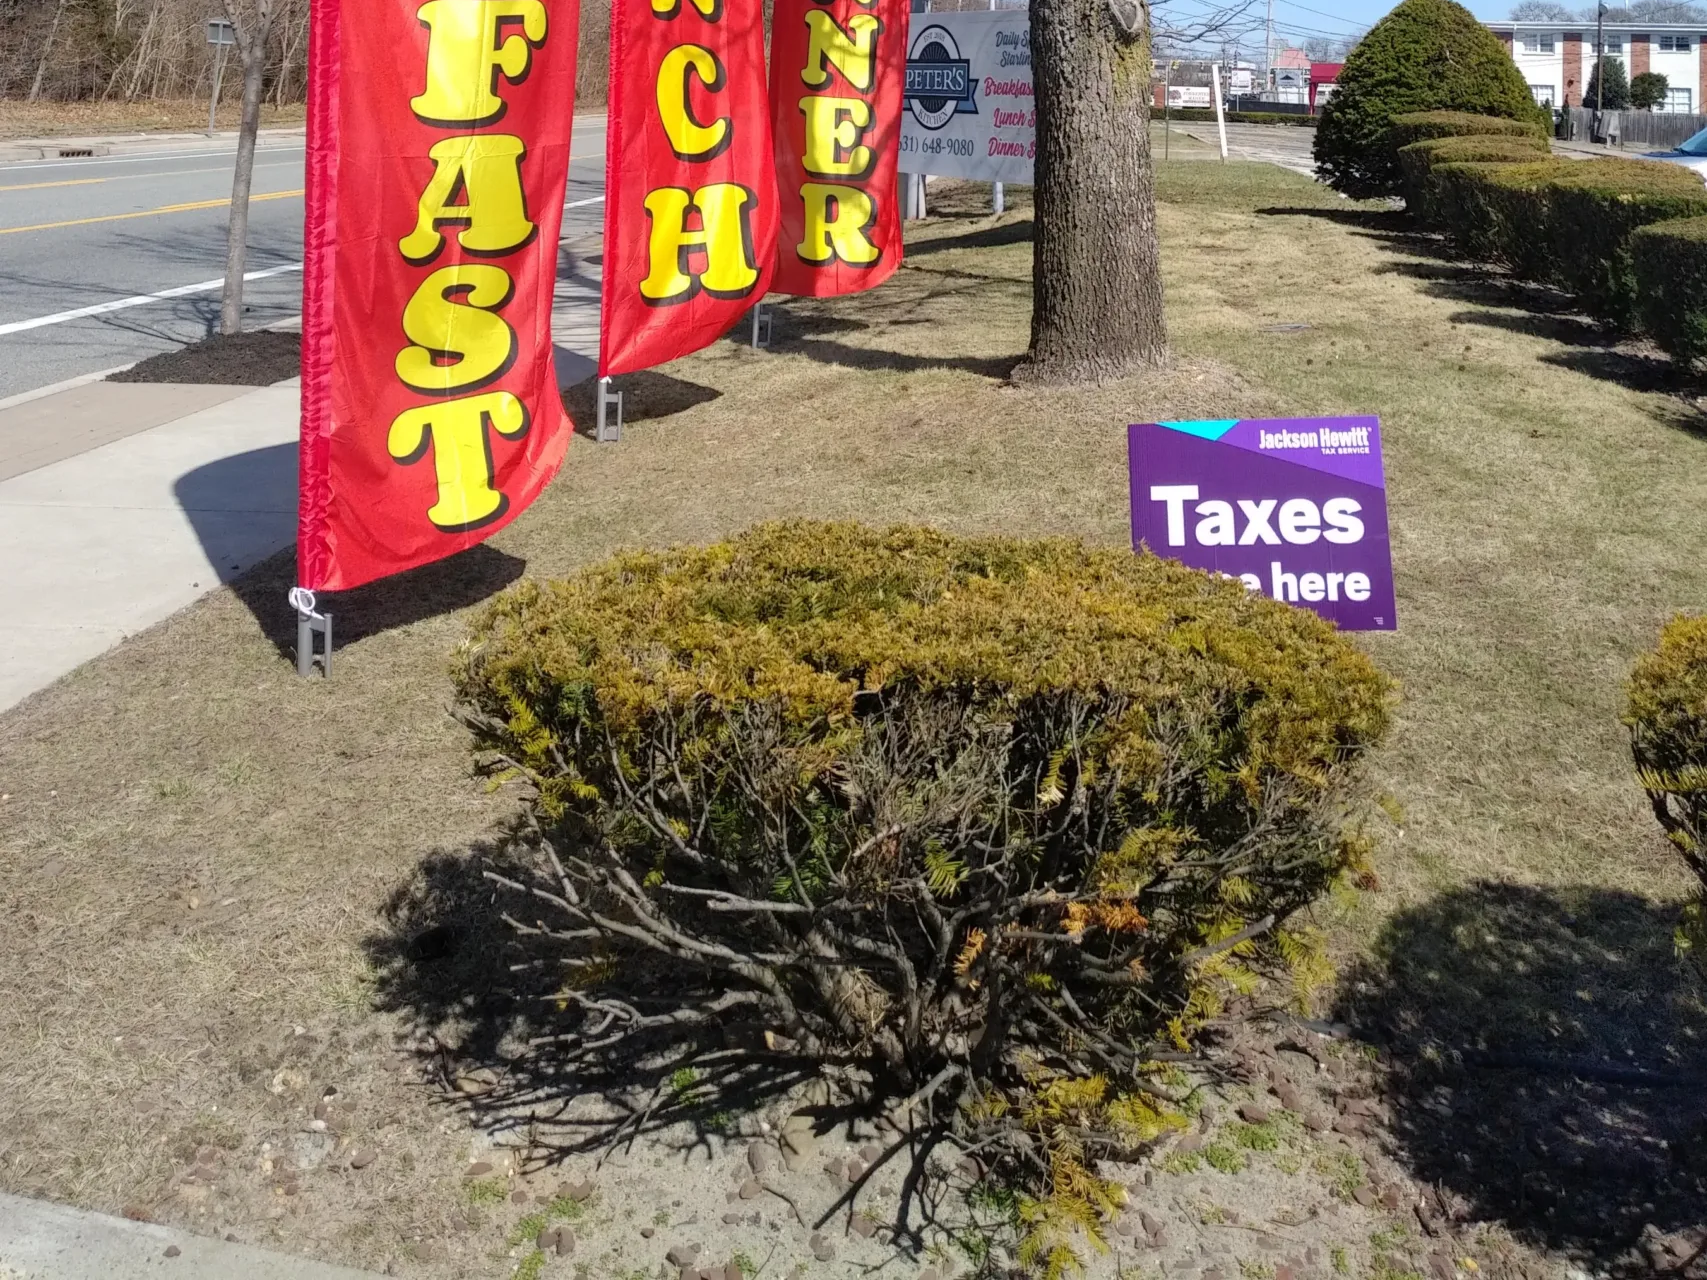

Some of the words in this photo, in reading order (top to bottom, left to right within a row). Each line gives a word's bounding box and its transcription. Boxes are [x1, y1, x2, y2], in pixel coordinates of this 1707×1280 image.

[995, 31, 1020, 50] Daily
[905, 66, 964, 91] PETER'S
[918, 108, 948, 125] KITCHEN
[993, 107, 1026, 129] Lunch
[922, 136, 974, 157] 648-9080
[988, 136, 1025, 158] Dinner
[1259, 429, 1318, 449] Jackson
[1319, 427, 1370, 447] Hewitt
[1338, 447, 1370, 455] SERVICE
[1150, 484, 1365, 546] Taxes
[1271, 561, 1371, 602] here
